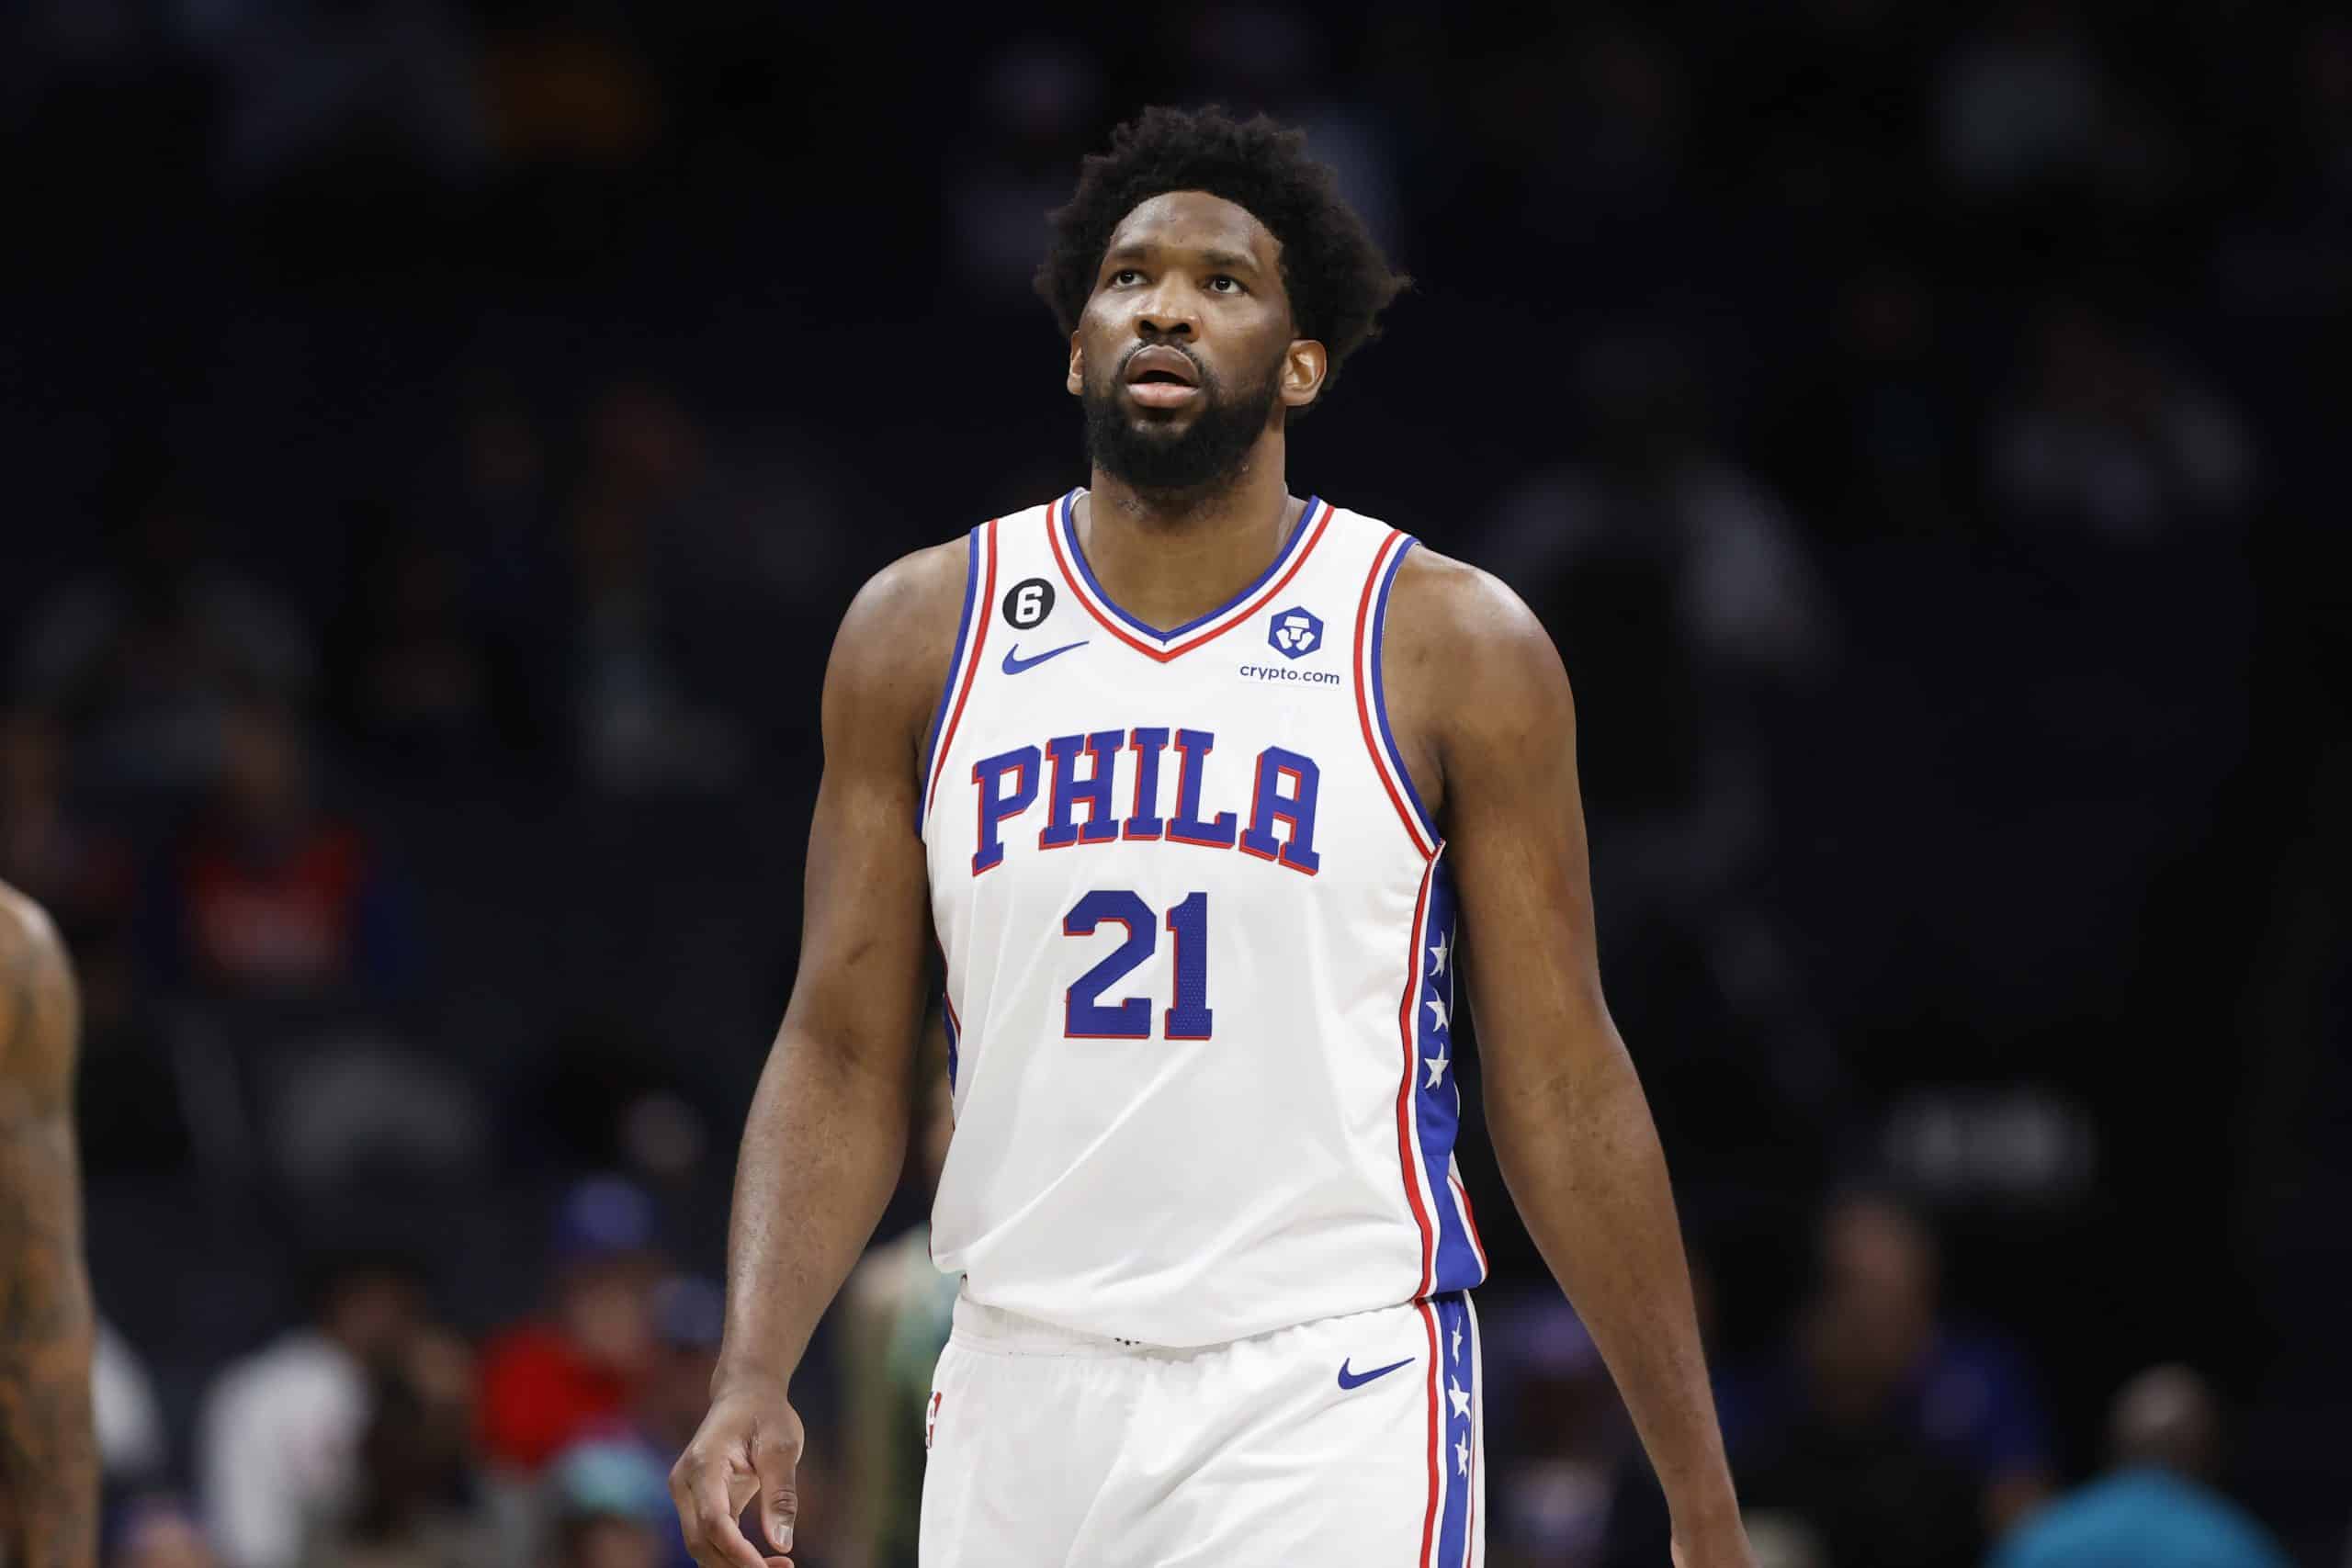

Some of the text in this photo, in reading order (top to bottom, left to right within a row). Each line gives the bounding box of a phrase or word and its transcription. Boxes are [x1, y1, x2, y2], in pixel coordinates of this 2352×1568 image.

[1015, 585, 1044, 624] 6
[1239, 665, 1340, 684] crypto.com
[972, 728, 1320, 876] PHILA
[1063, 890, 1213, 1041] 21
